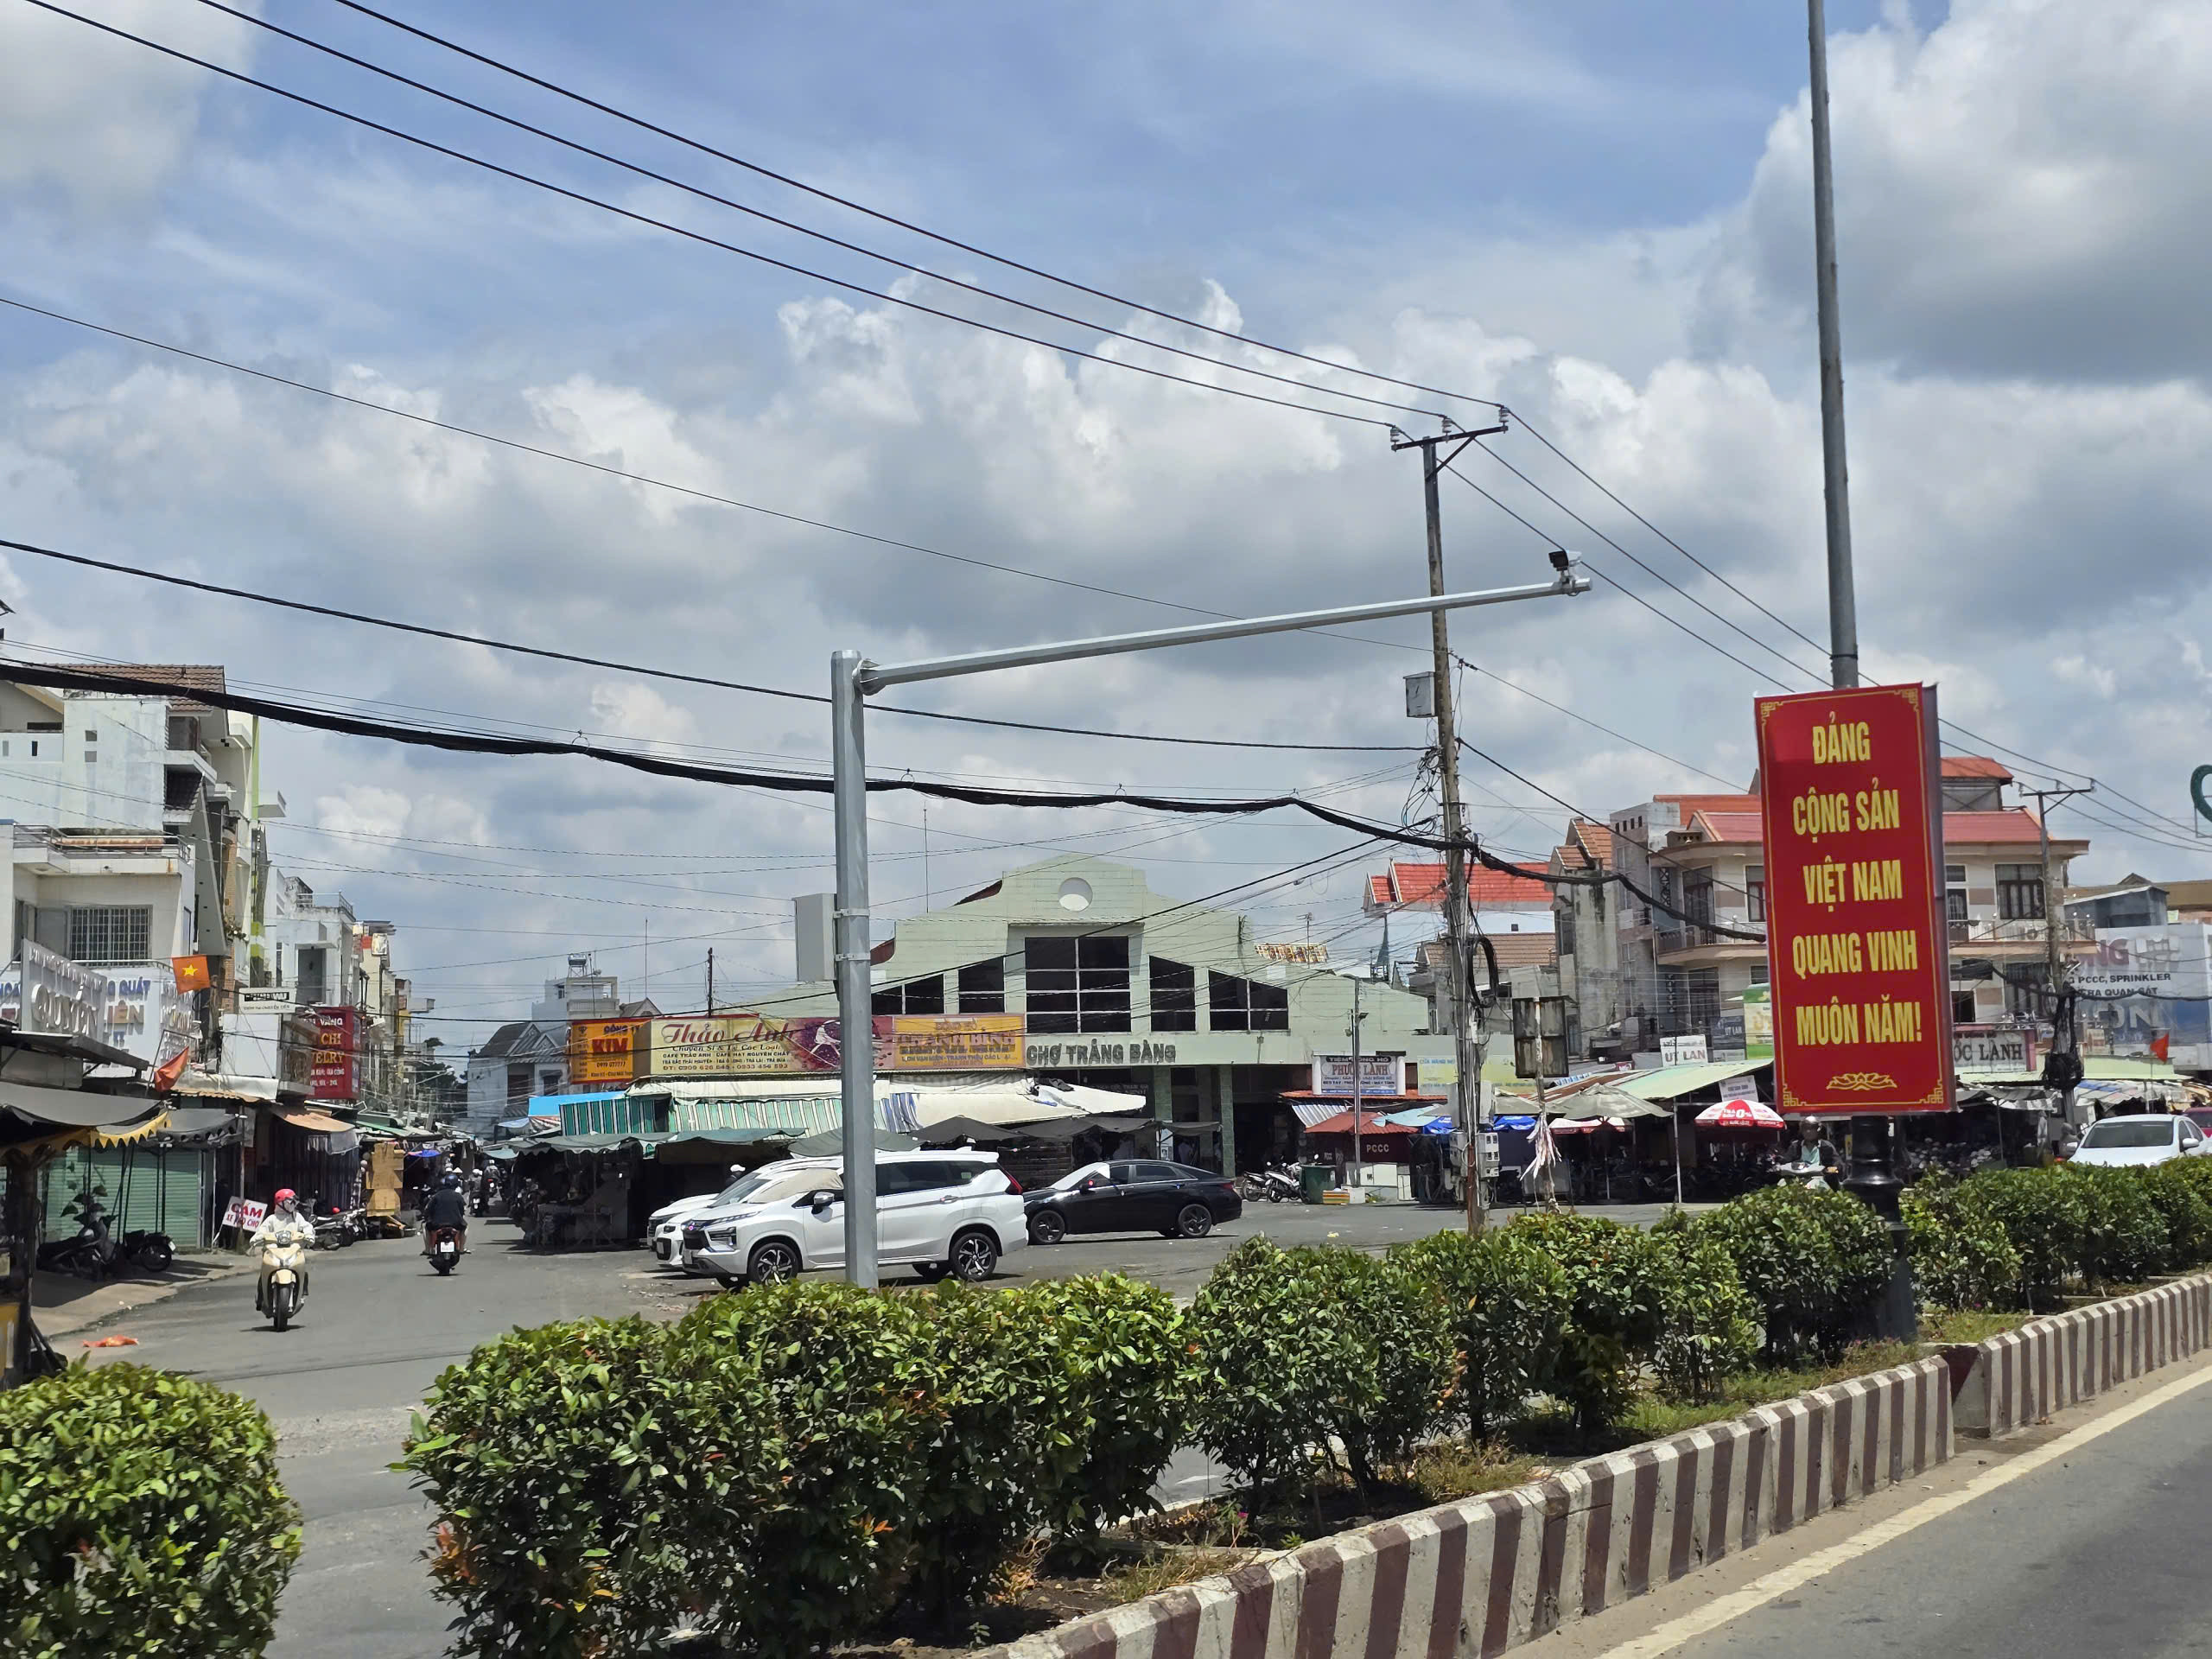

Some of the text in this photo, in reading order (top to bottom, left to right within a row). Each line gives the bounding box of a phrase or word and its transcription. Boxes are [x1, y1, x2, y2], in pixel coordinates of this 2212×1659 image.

[1812, 711, 1871, 765] ĐẢNG
[1792, 777, 1900, 843] CỘNG SẢN
[1802, 855, 1903, 912] VIỆT NAM
[1792, 930, 1918, 980] QUANG VINH
[119, 976, 151, 995] QUÁT
[2078, 976, 2108, 984] PCCC,
[2109, 973, 2171, 983] SPRINKLER
[1796, 995, 1859, 1046] MUÔN
[1864, 994, 1922, 1043] NĂM!
[661, 1023, 725, 1044] Thảo
[1065, 1038, 1124, 1065] TRẢNG
[1129, 1039, 1176, 1064] BÀNG
[1682, 1049, 1706, 1061] LAN
[1978, 1039, 2024, 1061] LÀNH
[1366, 1143, 1390, 1153] PCCC
